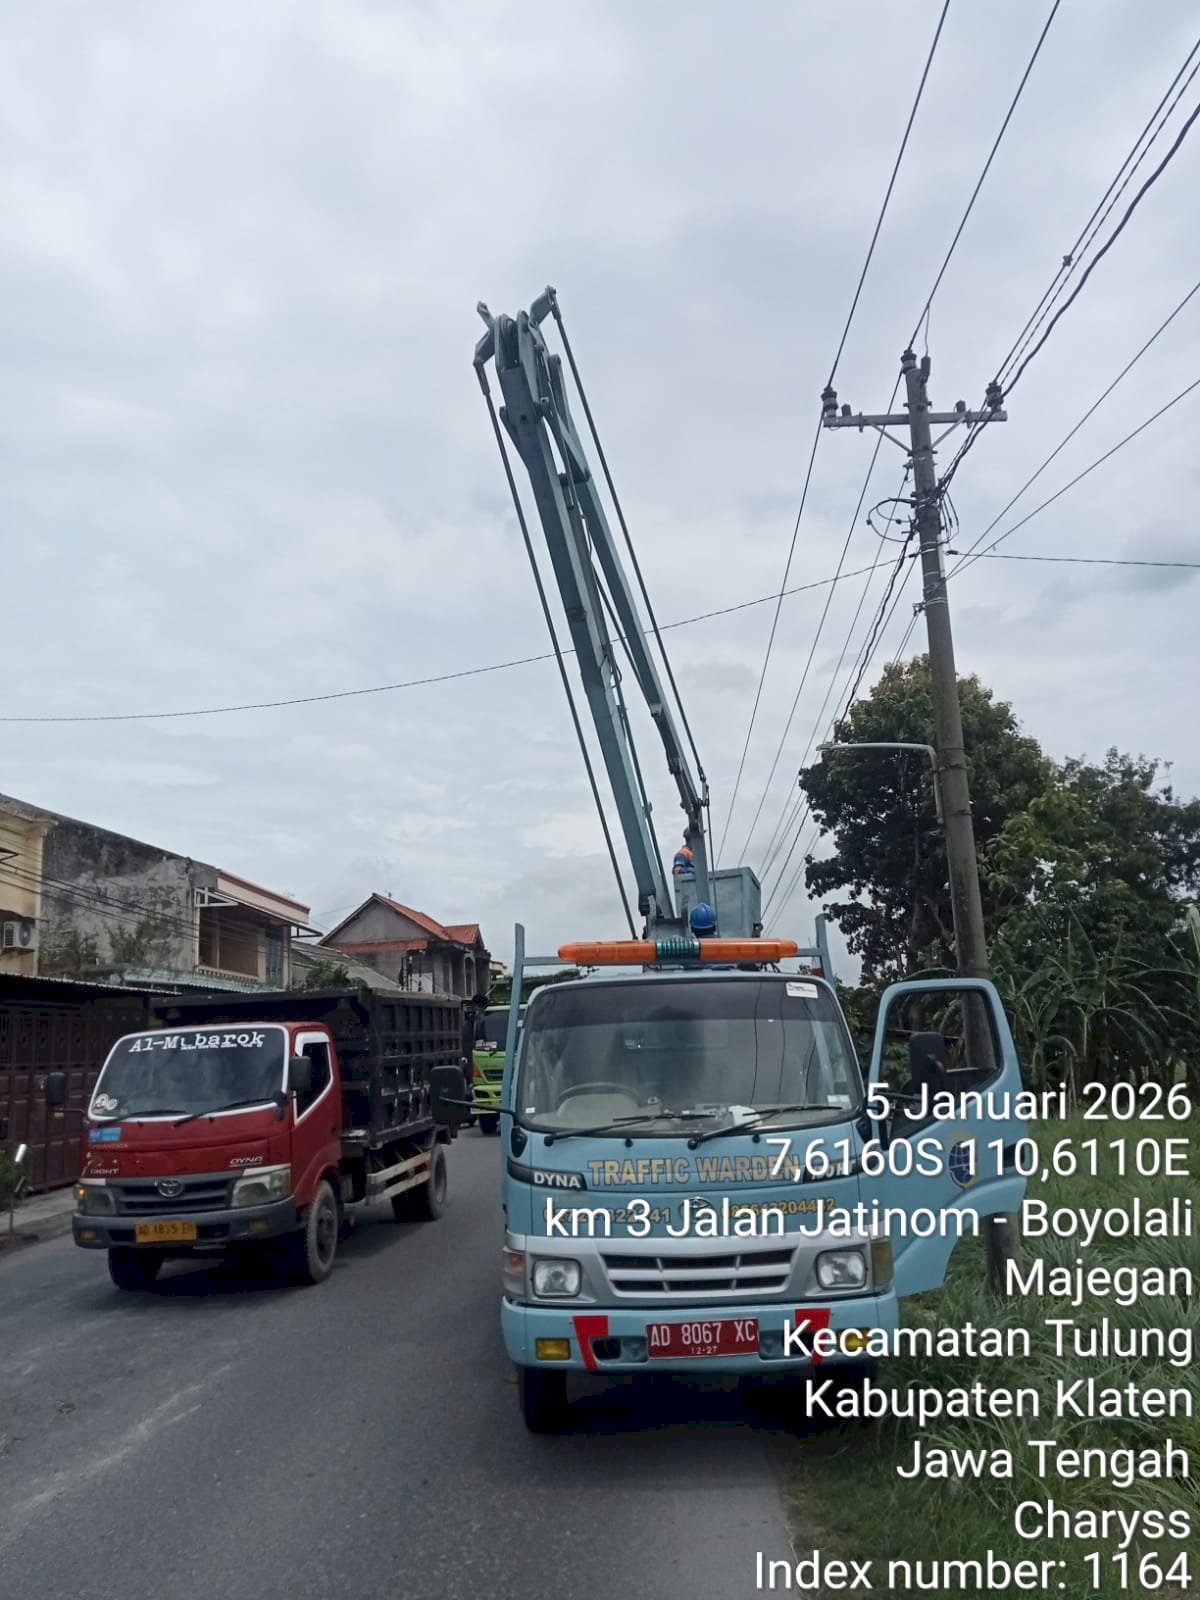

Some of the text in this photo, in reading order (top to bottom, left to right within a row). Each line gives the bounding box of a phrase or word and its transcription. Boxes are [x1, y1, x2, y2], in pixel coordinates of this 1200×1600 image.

[533, 1171, 581, 1189] DYNA
[587, 1155, 800, 1186] TRAFFIC WARDEN
[650, 1320, 756, 1346] AD 8067 XC
